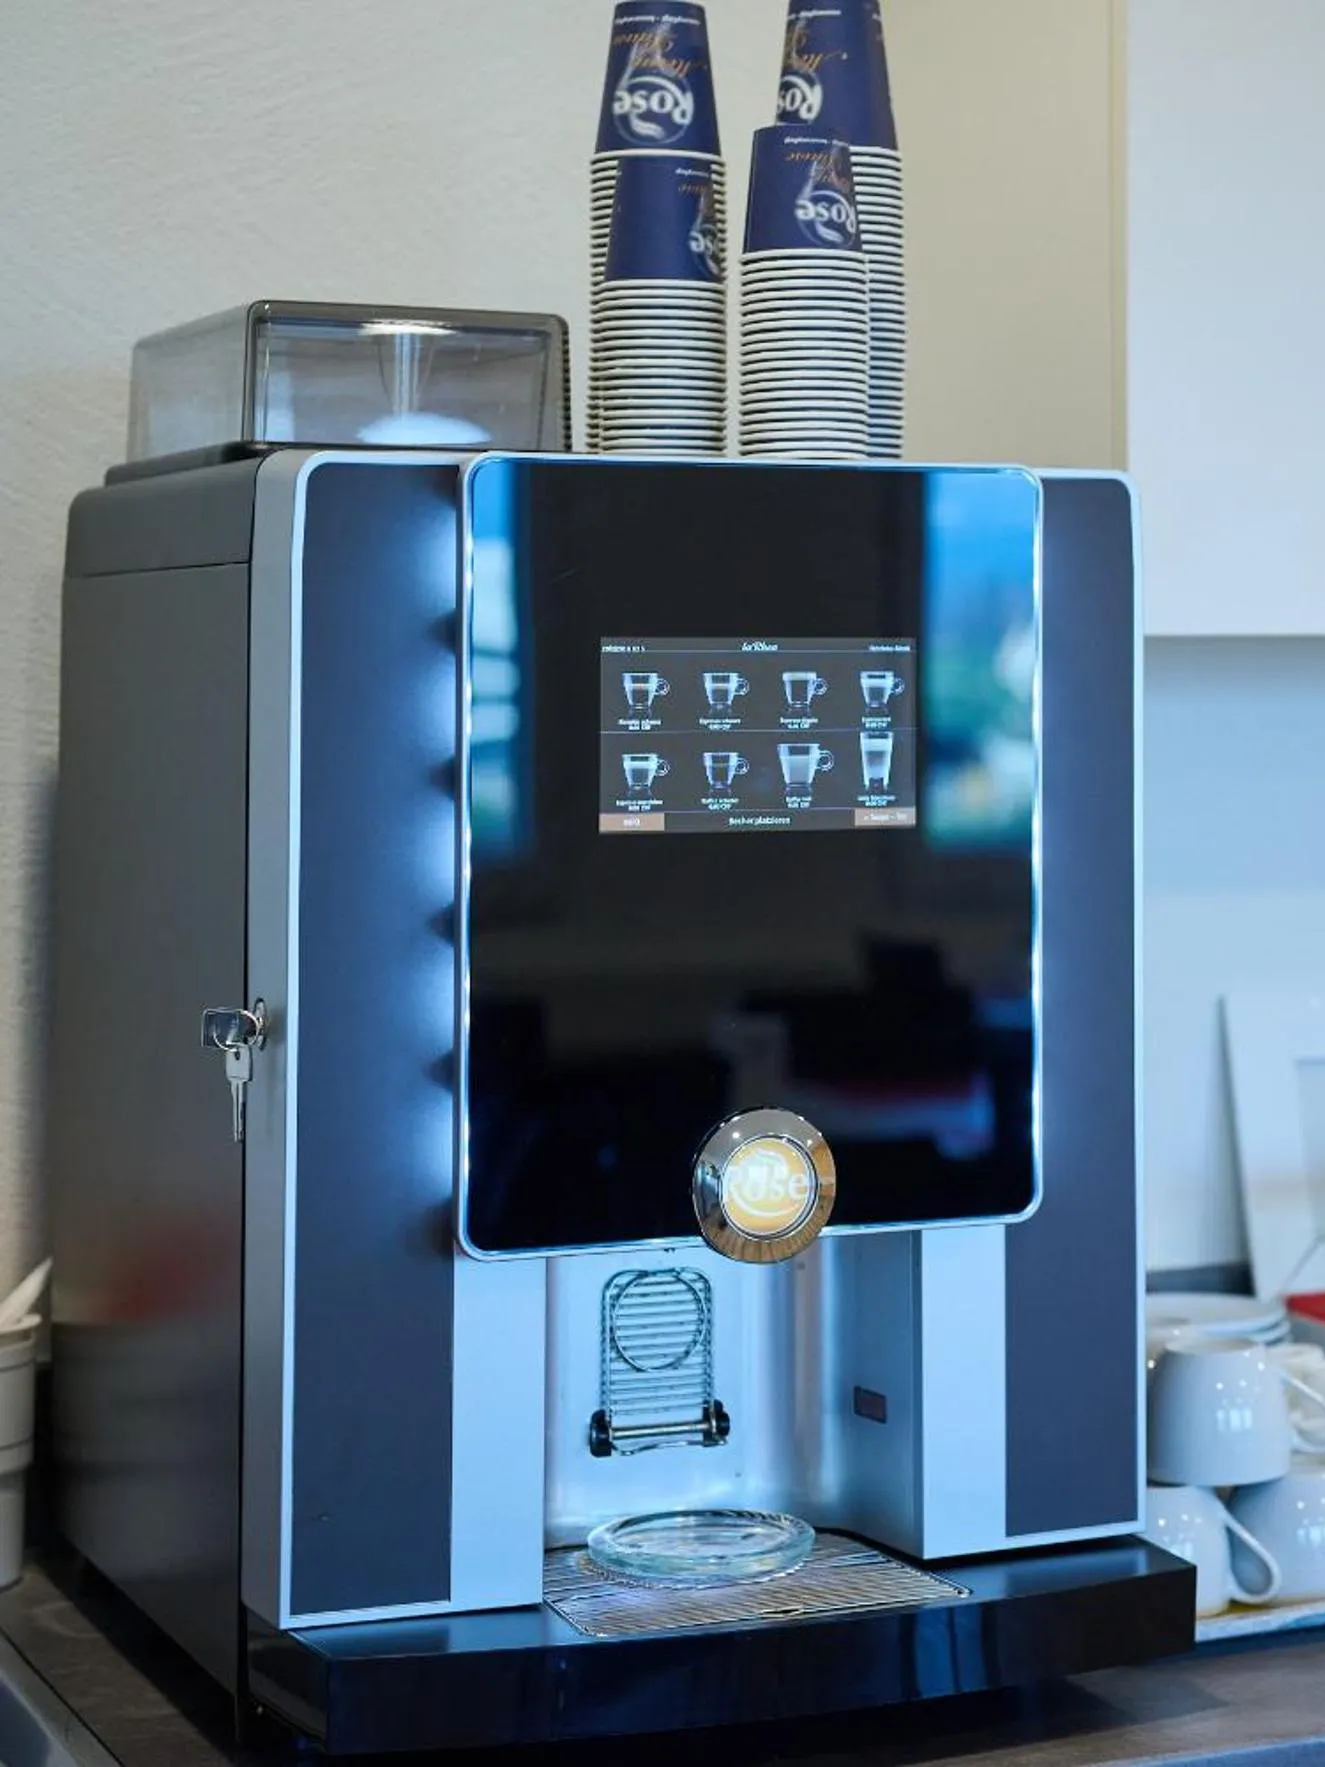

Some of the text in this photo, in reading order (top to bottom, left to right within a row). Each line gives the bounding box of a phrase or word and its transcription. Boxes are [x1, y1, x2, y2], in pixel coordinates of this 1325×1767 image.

[612, 78, 694, 126] Rose
[777, 76, 823, 121] Ros
[794, 193, 857, 234] Rose
[723, 1165, 808, 1214] Rose
